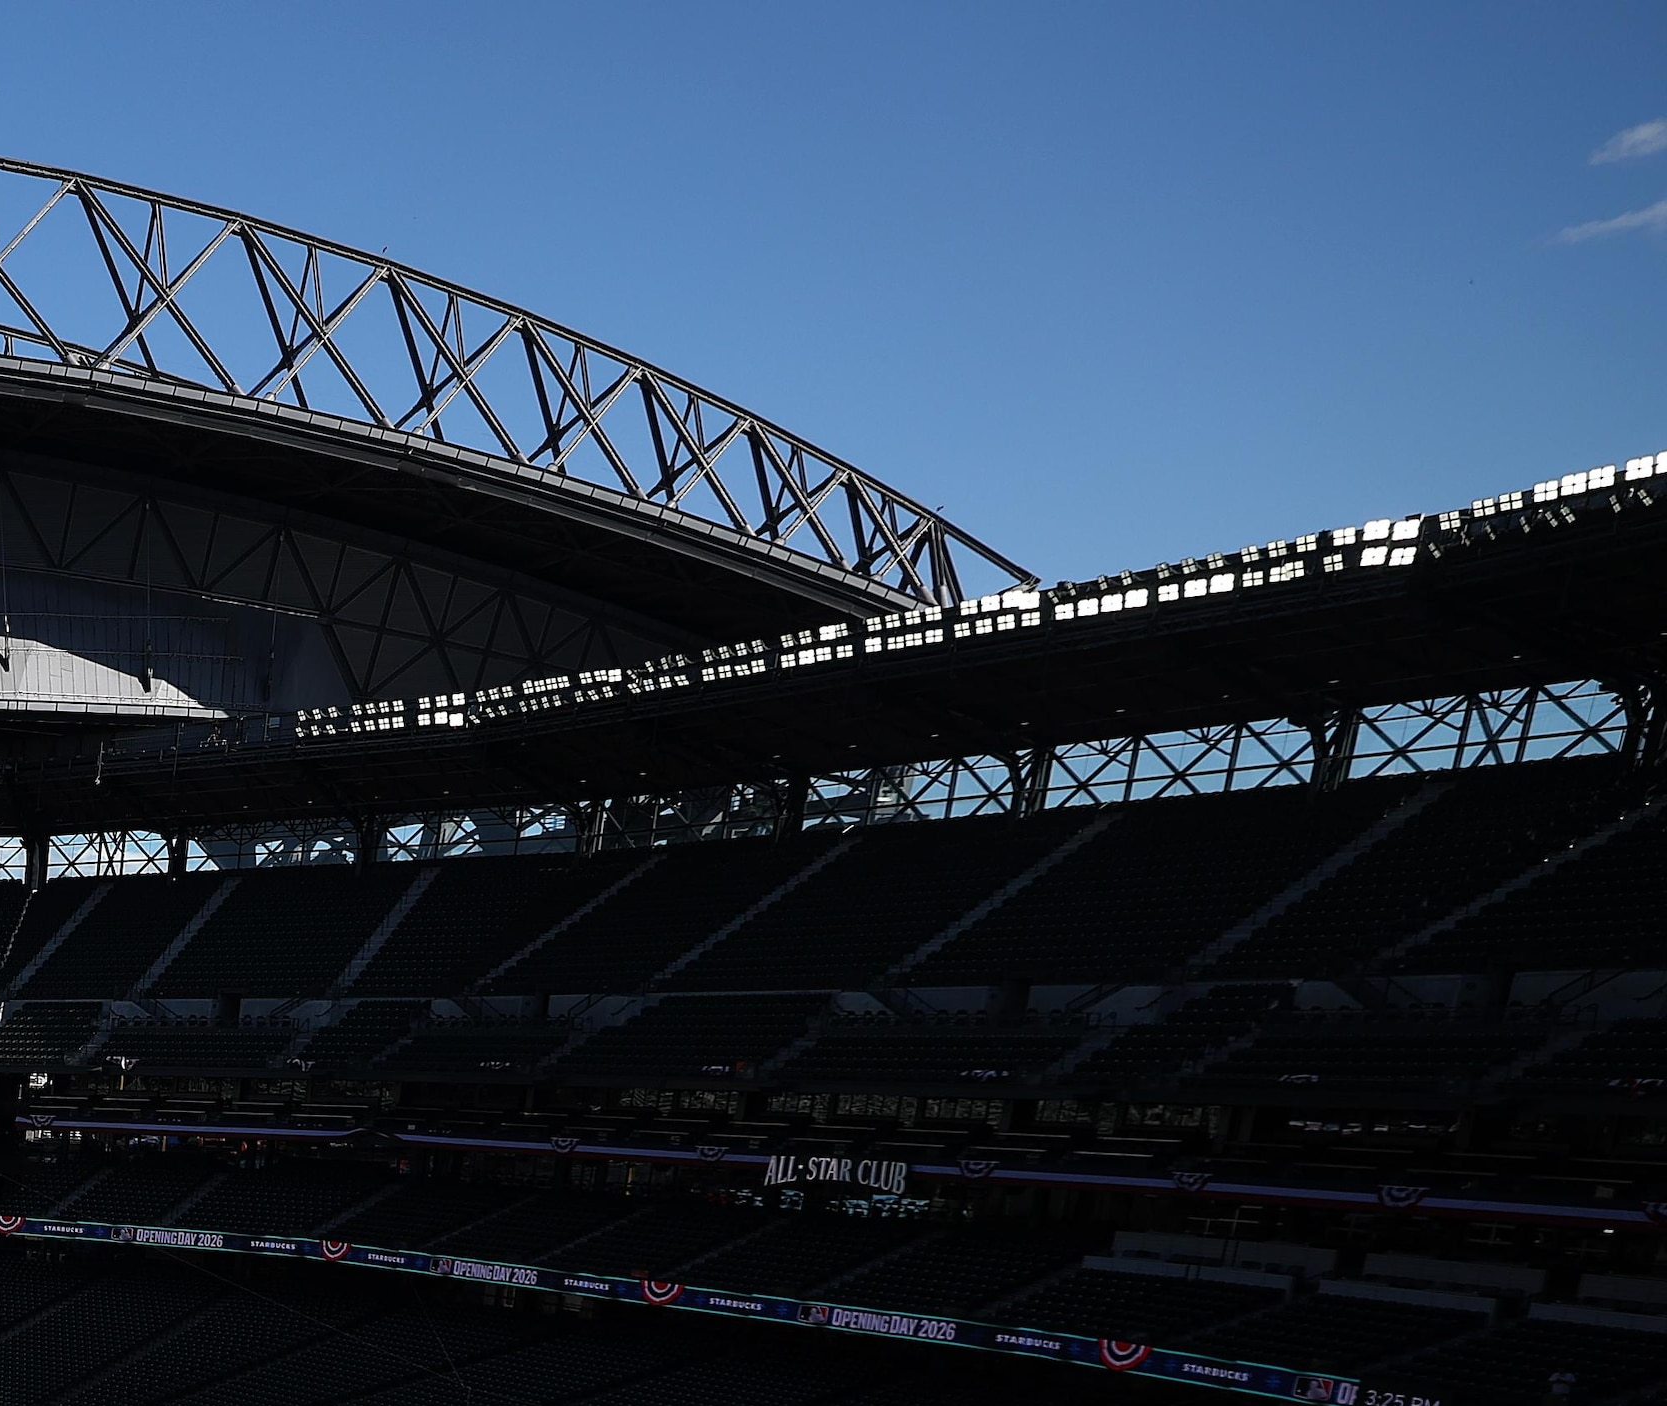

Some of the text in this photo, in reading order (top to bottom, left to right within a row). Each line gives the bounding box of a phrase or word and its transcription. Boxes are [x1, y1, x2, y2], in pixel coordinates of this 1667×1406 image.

[857, 1160, 908, 1194] CLUB
[43, 1225, 1249, 1382] STARBUCKS OPENING DAY 2026 STARBUCKS STARBUCKS OPENING DAY 2026 STARBUCKS STARBUCKS OPENING DAY 2026 STARBUCKS STARBUCKS
